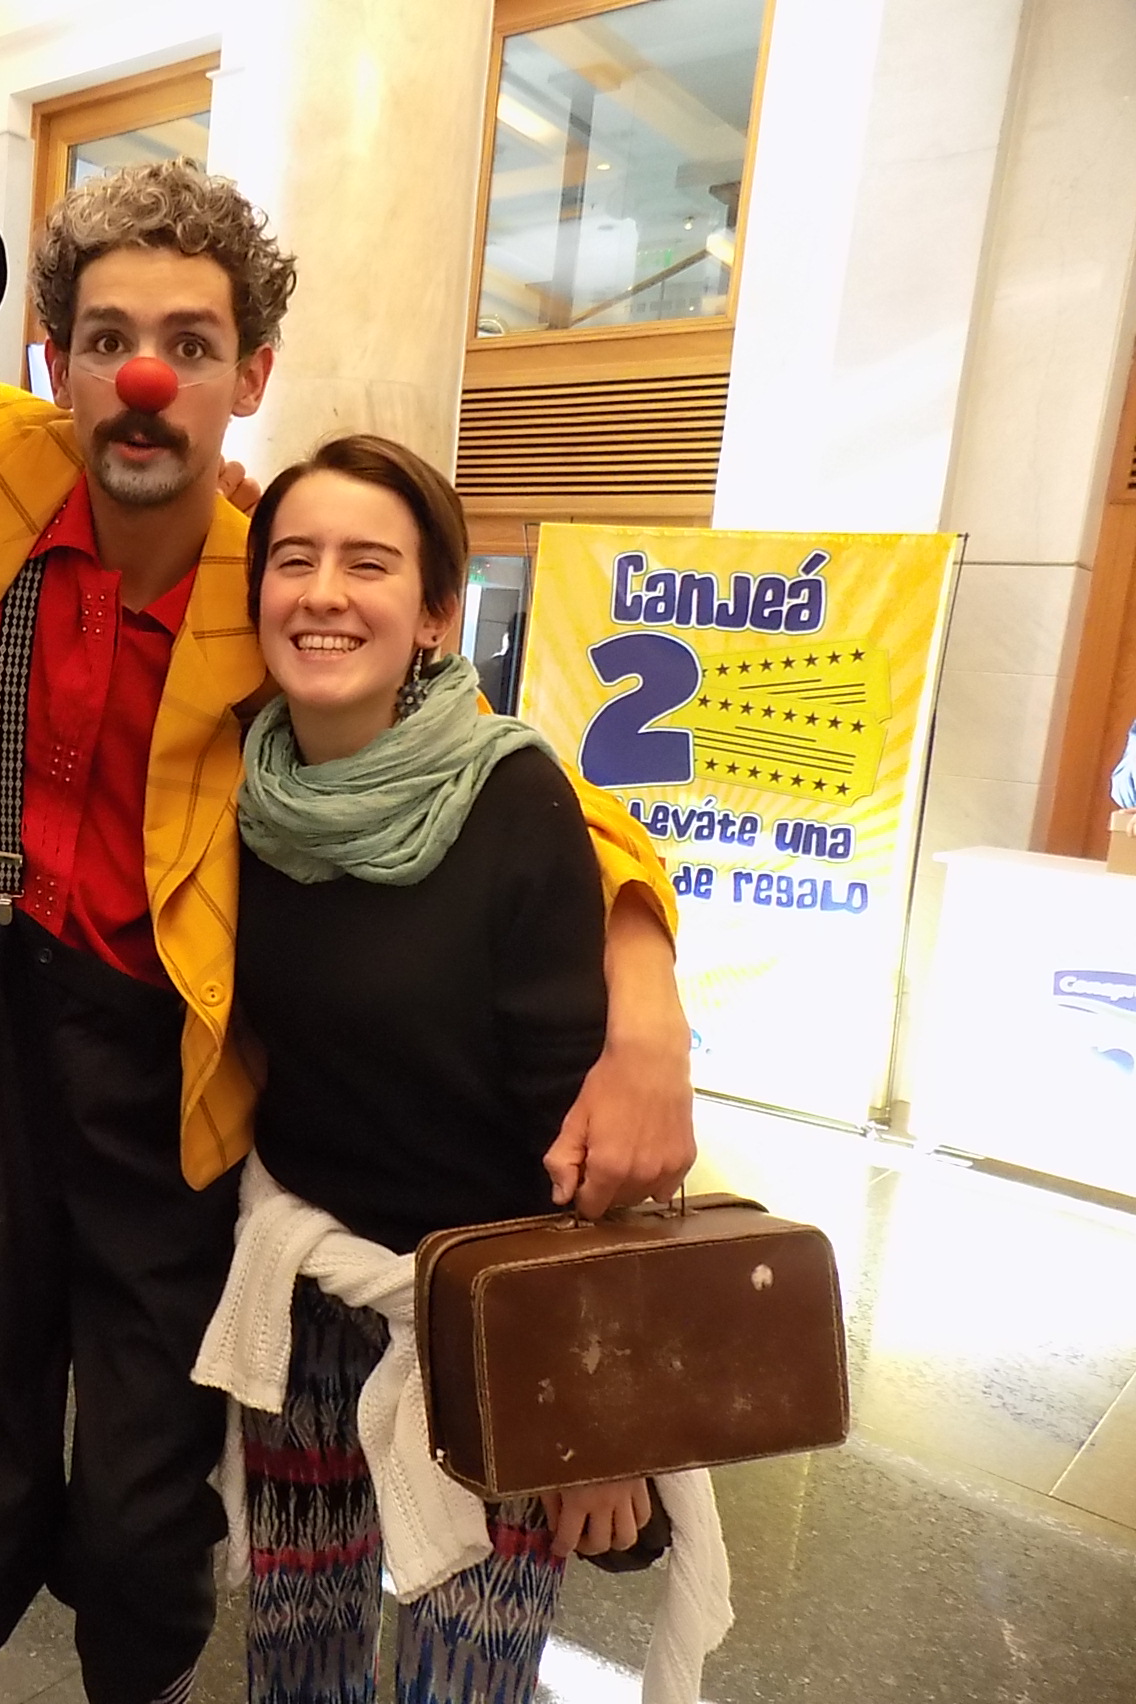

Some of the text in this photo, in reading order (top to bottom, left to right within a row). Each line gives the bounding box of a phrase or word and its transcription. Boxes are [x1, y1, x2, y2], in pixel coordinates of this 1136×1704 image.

[582, 632, 700, 788] 2
[774, 820, 852, 860] una
[672, 865, 714, 900] de
